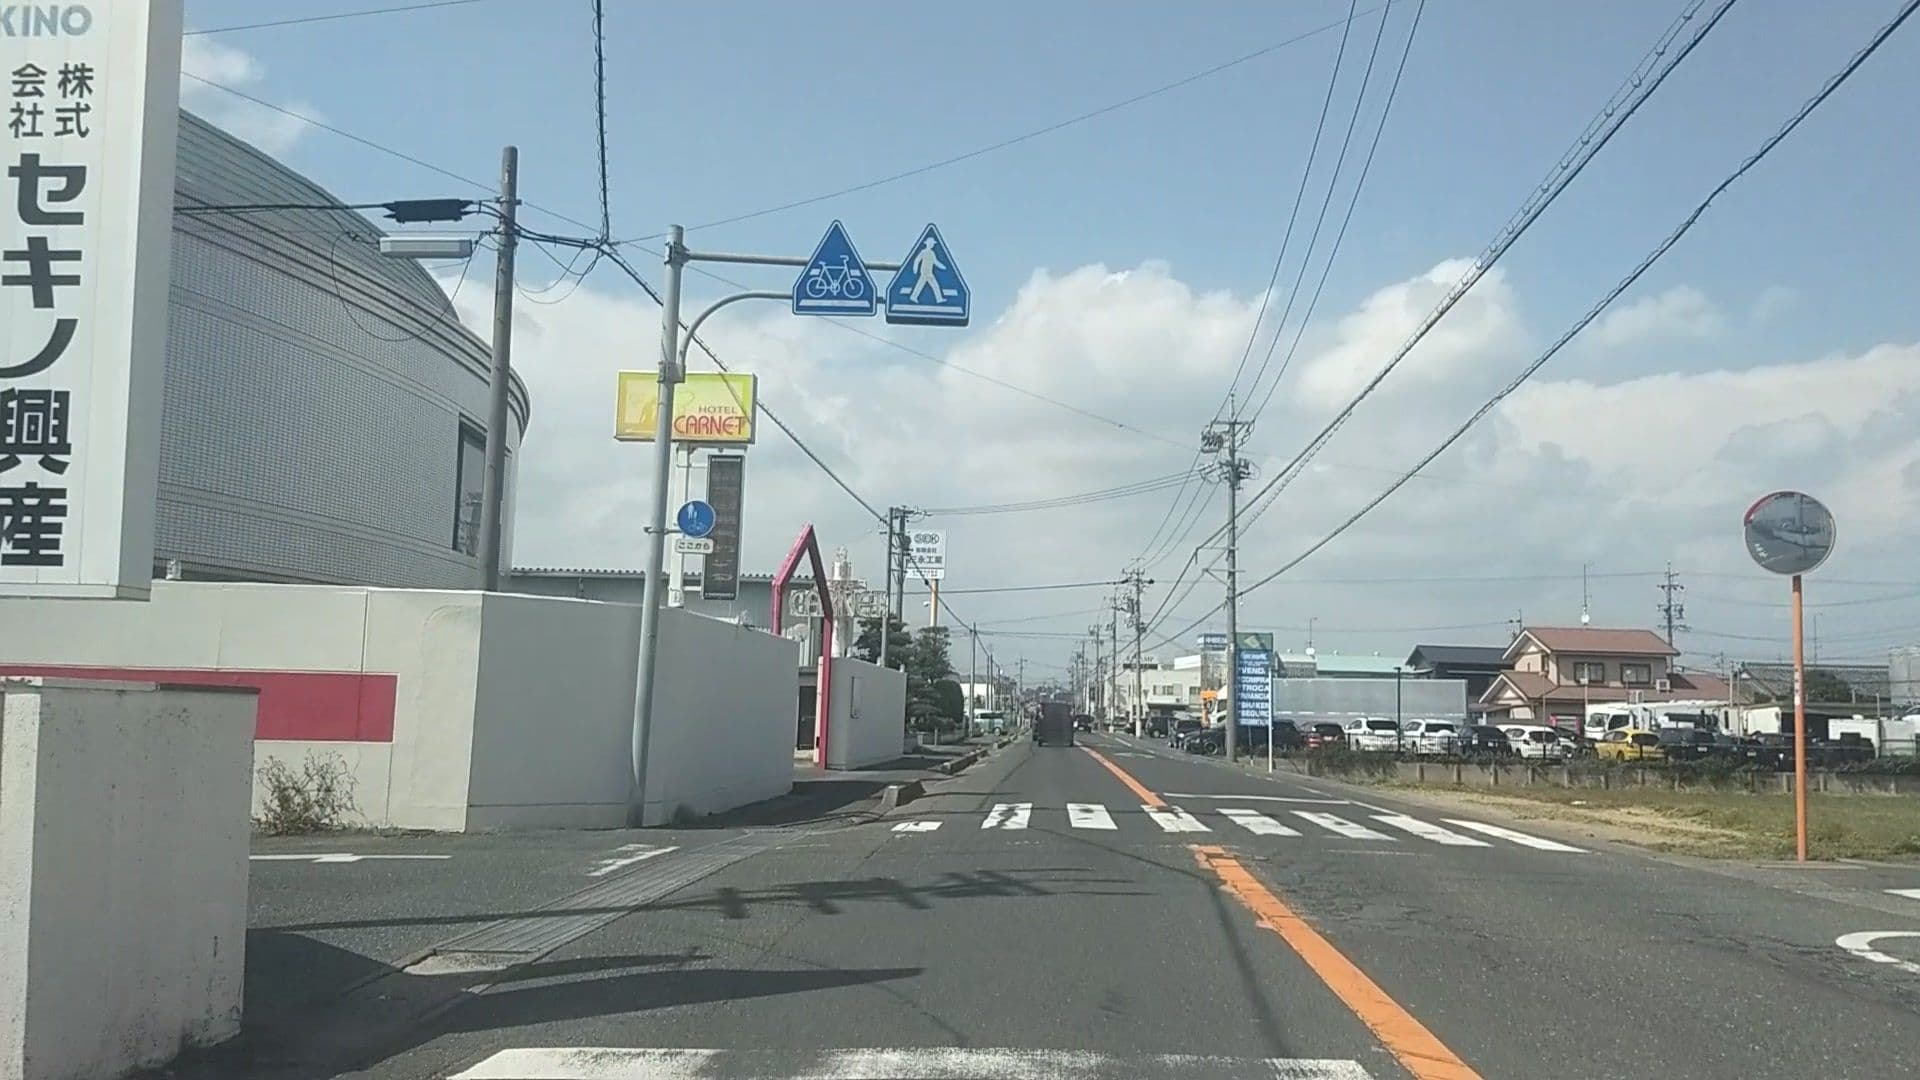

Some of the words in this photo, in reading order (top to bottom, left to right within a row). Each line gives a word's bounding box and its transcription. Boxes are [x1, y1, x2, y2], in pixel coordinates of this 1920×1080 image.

[8, 62, 47, 139] 会社
[54, 62, 94, 139] 株式
[0, 153, 87, 566] セキノ興産
[673, 415, 747, 436] CARNET
[698, 405, 737, 414] HOTEL
[679, 541, 710, 550] ここから
